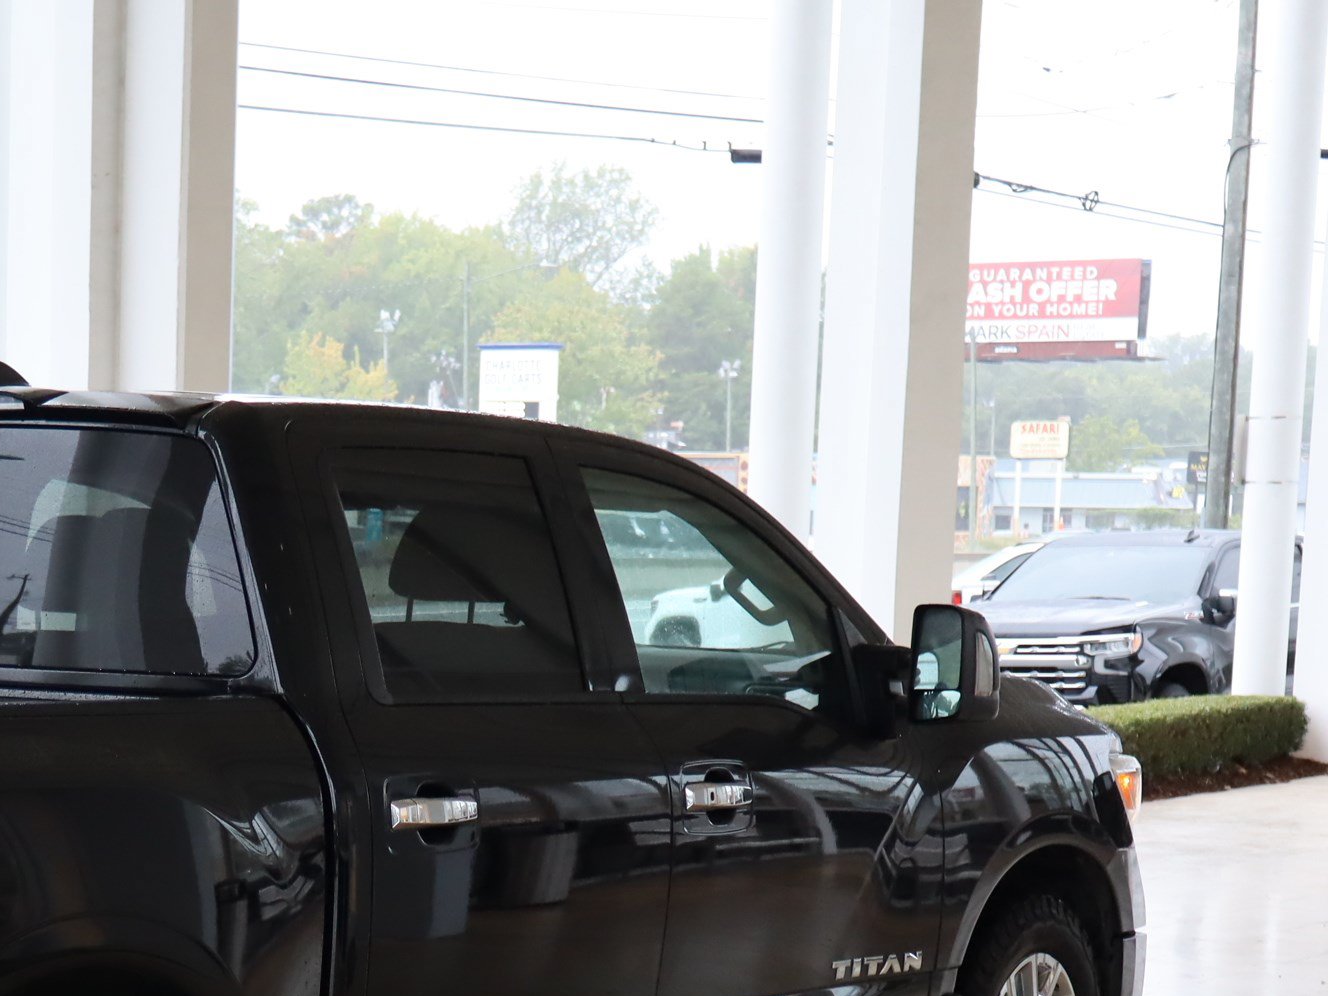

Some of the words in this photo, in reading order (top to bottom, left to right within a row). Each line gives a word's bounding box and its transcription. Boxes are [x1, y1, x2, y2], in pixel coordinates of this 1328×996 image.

[969, 266, 1099, 282] GUARANTEED
[967, 280, 1023, 304] ASH
[1028, 278, 1118, 303] OFFER
[991, 302, 1040, 318] YOUR
[1046, 301, 1104, 317] HOME!
[965, 324, 1011, 340] ARK
[1014, 322, 1070, 340] SPAIN
[832, 951, 923, 980] TITAN
